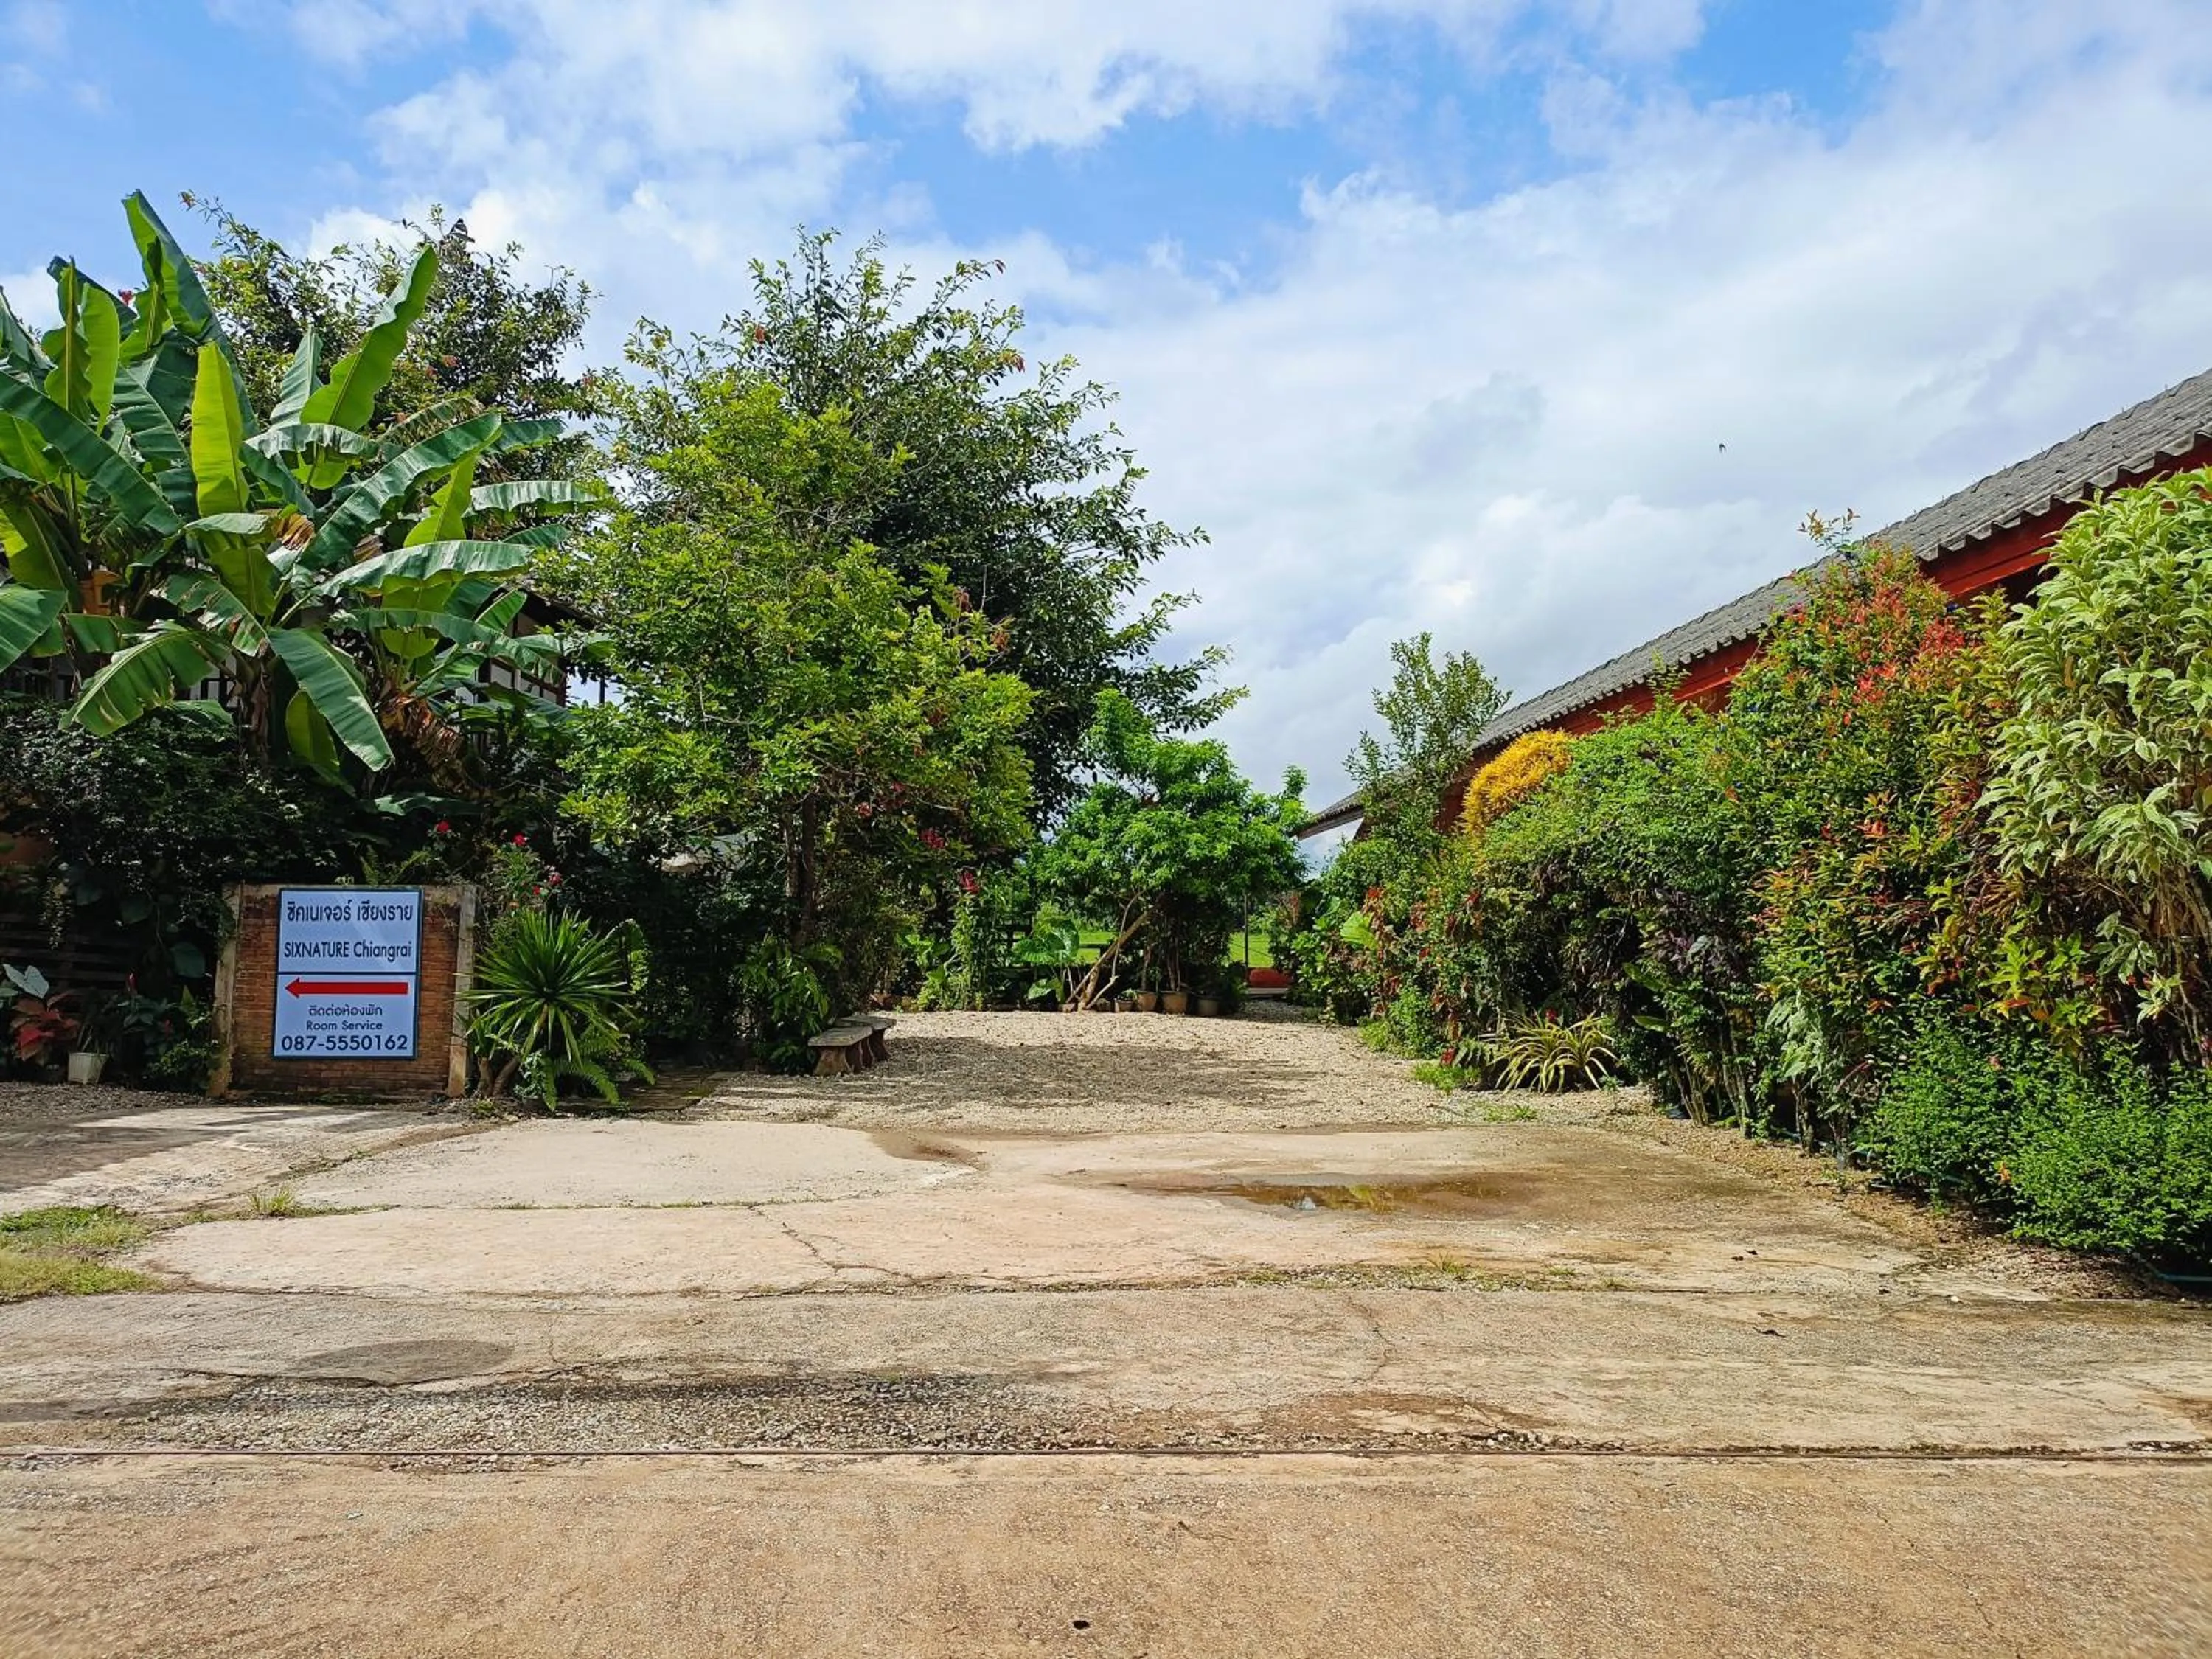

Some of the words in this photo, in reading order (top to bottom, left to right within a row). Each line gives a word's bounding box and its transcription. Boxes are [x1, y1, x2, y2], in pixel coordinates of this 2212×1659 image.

[357, 900, 413, 921] เชียงราย
[284, 942, 349, 958] SIXNATURE
[353, 941, 411, 962] Chiangrai
[306, 1020, 337, 1030] Room
[341, 1020, 383, 1030] Service
[282, 1035, 408, 1051] 087-5550162
